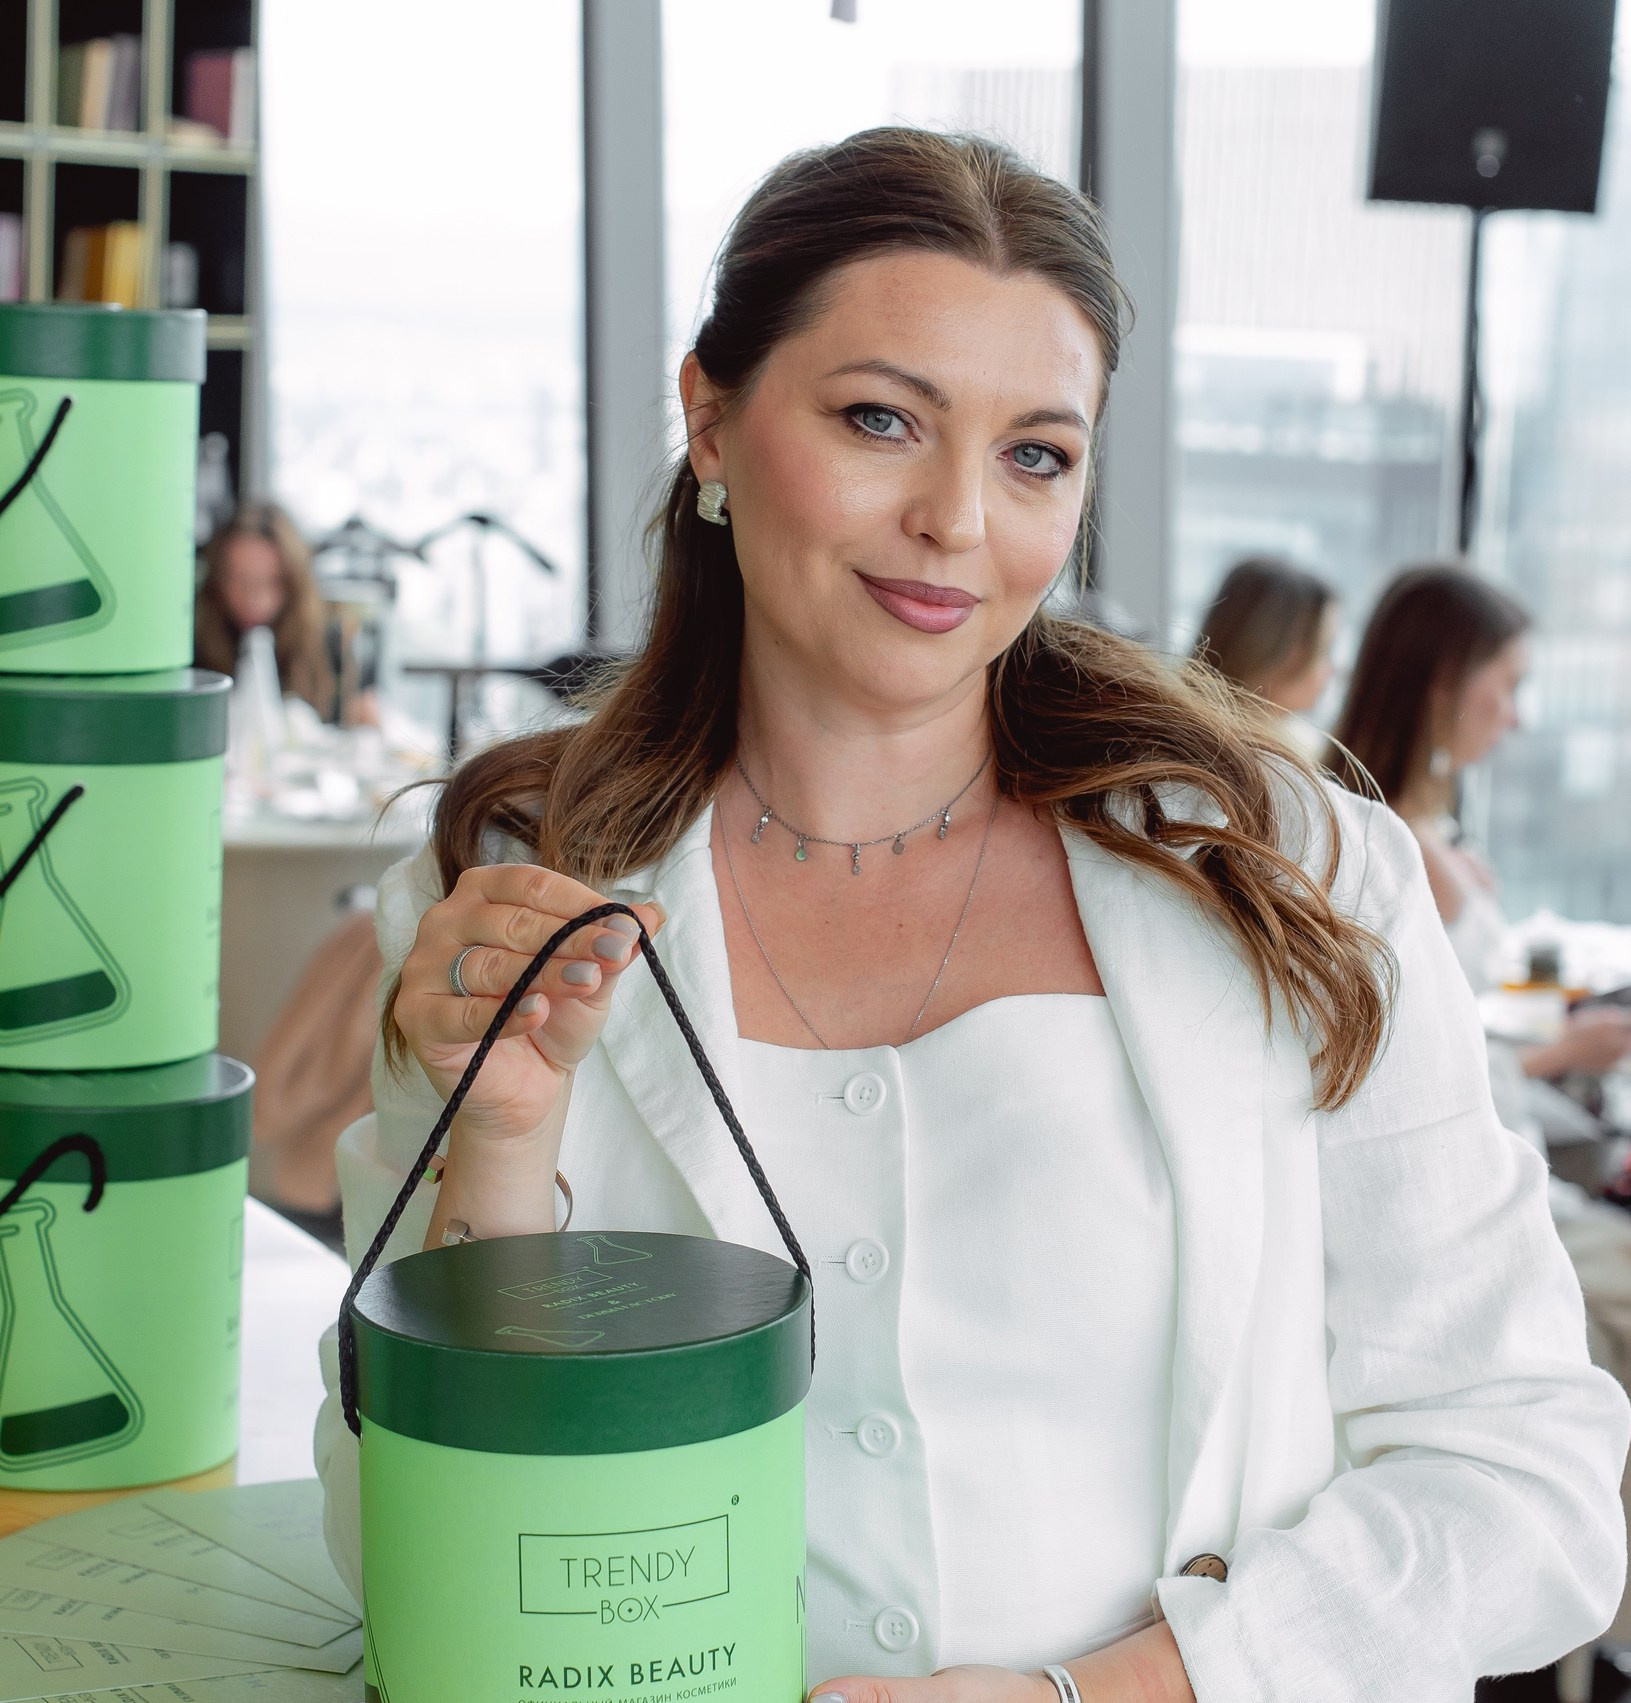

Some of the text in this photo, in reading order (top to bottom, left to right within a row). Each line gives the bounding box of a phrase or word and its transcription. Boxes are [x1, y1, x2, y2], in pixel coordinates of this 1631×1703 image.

[541, 1295, 587, 1310] RADIX
[587, 1282, 639, 1298] BEAUTY
[559, 1545, 696, 1589] TRENDY
[600, 1594, 660, 1625] BOX
[518, 1642, 737, 1689] RADIX BEAUTY
[676, 1676, 737, 1701] КОСМЕТИКИ
